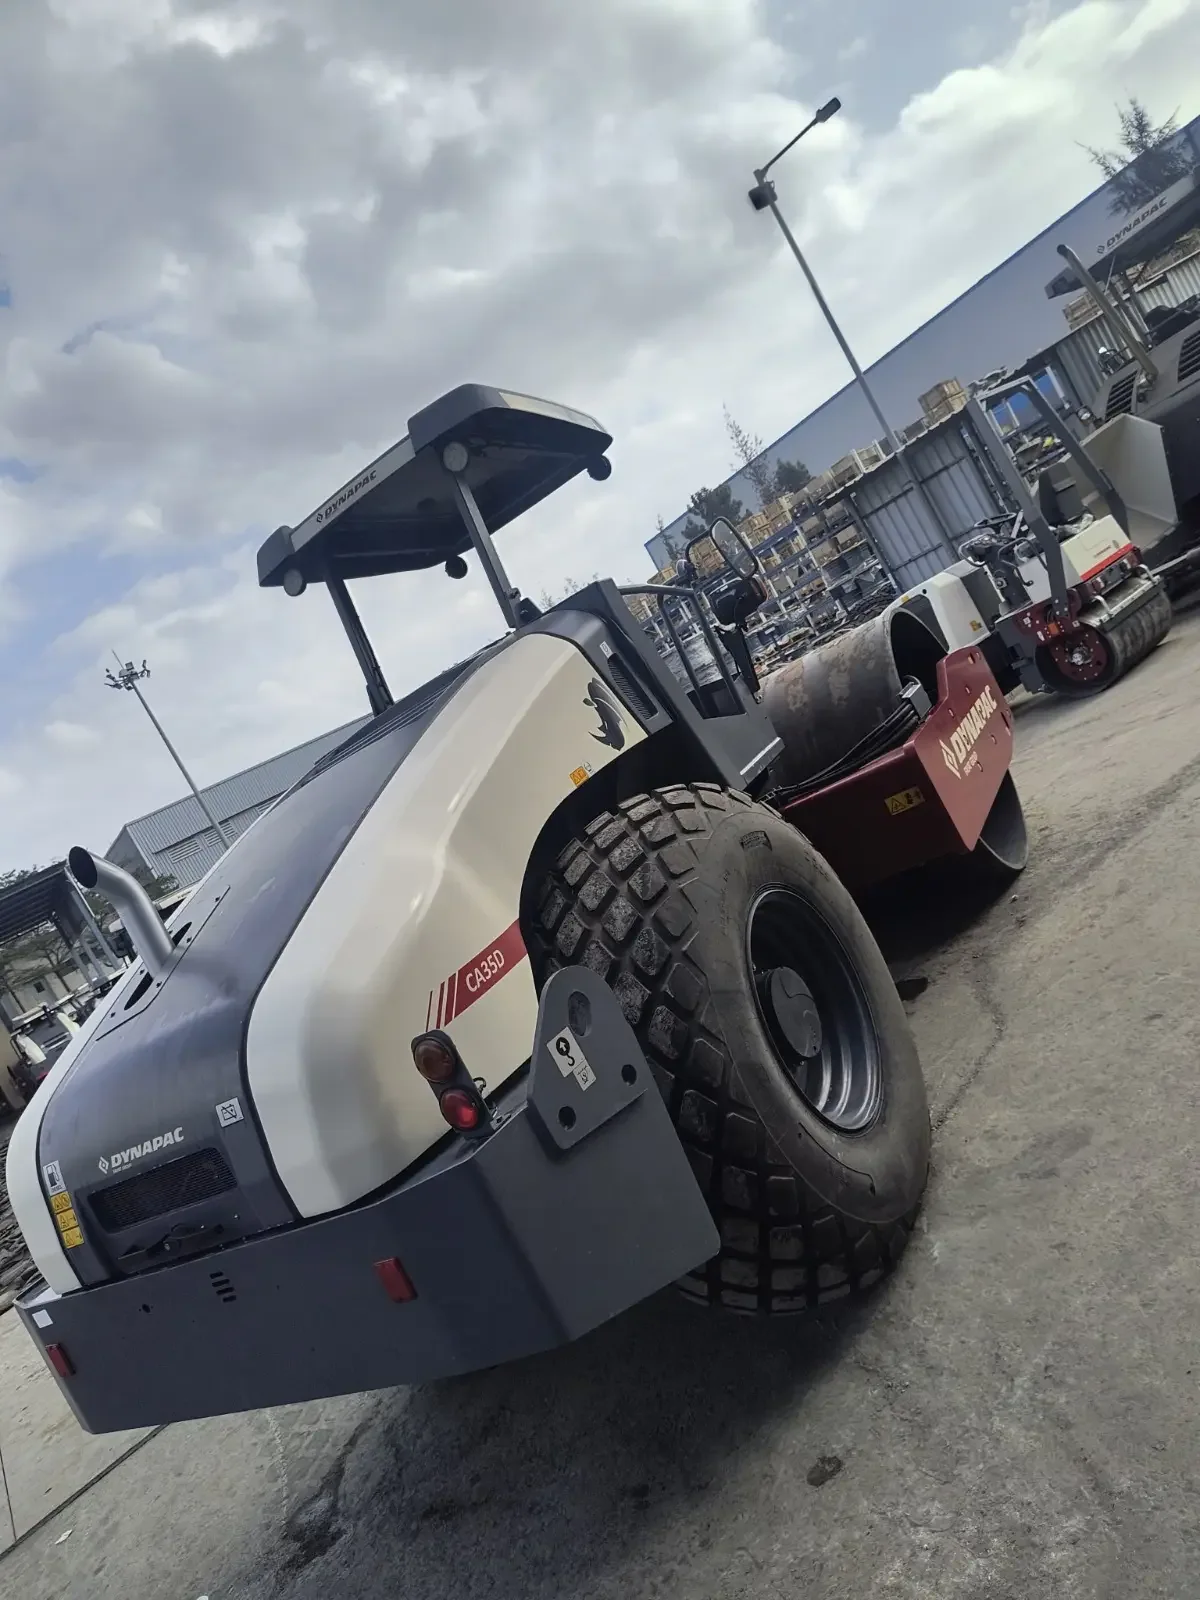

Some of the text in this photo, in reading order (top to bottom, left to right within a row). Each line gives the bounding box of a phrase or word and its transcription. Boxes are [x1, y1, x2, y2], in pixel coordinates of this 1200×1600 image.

[1106, 196, 1168, 248] DYNAPAC
[324, 469, 377, 519] DYNAPAC
[950, 684, 998, 764] DYNAPAC
[465, 949, 505, 992] CA35D
[110, 1126, 185, 1168] DYNAPAC
